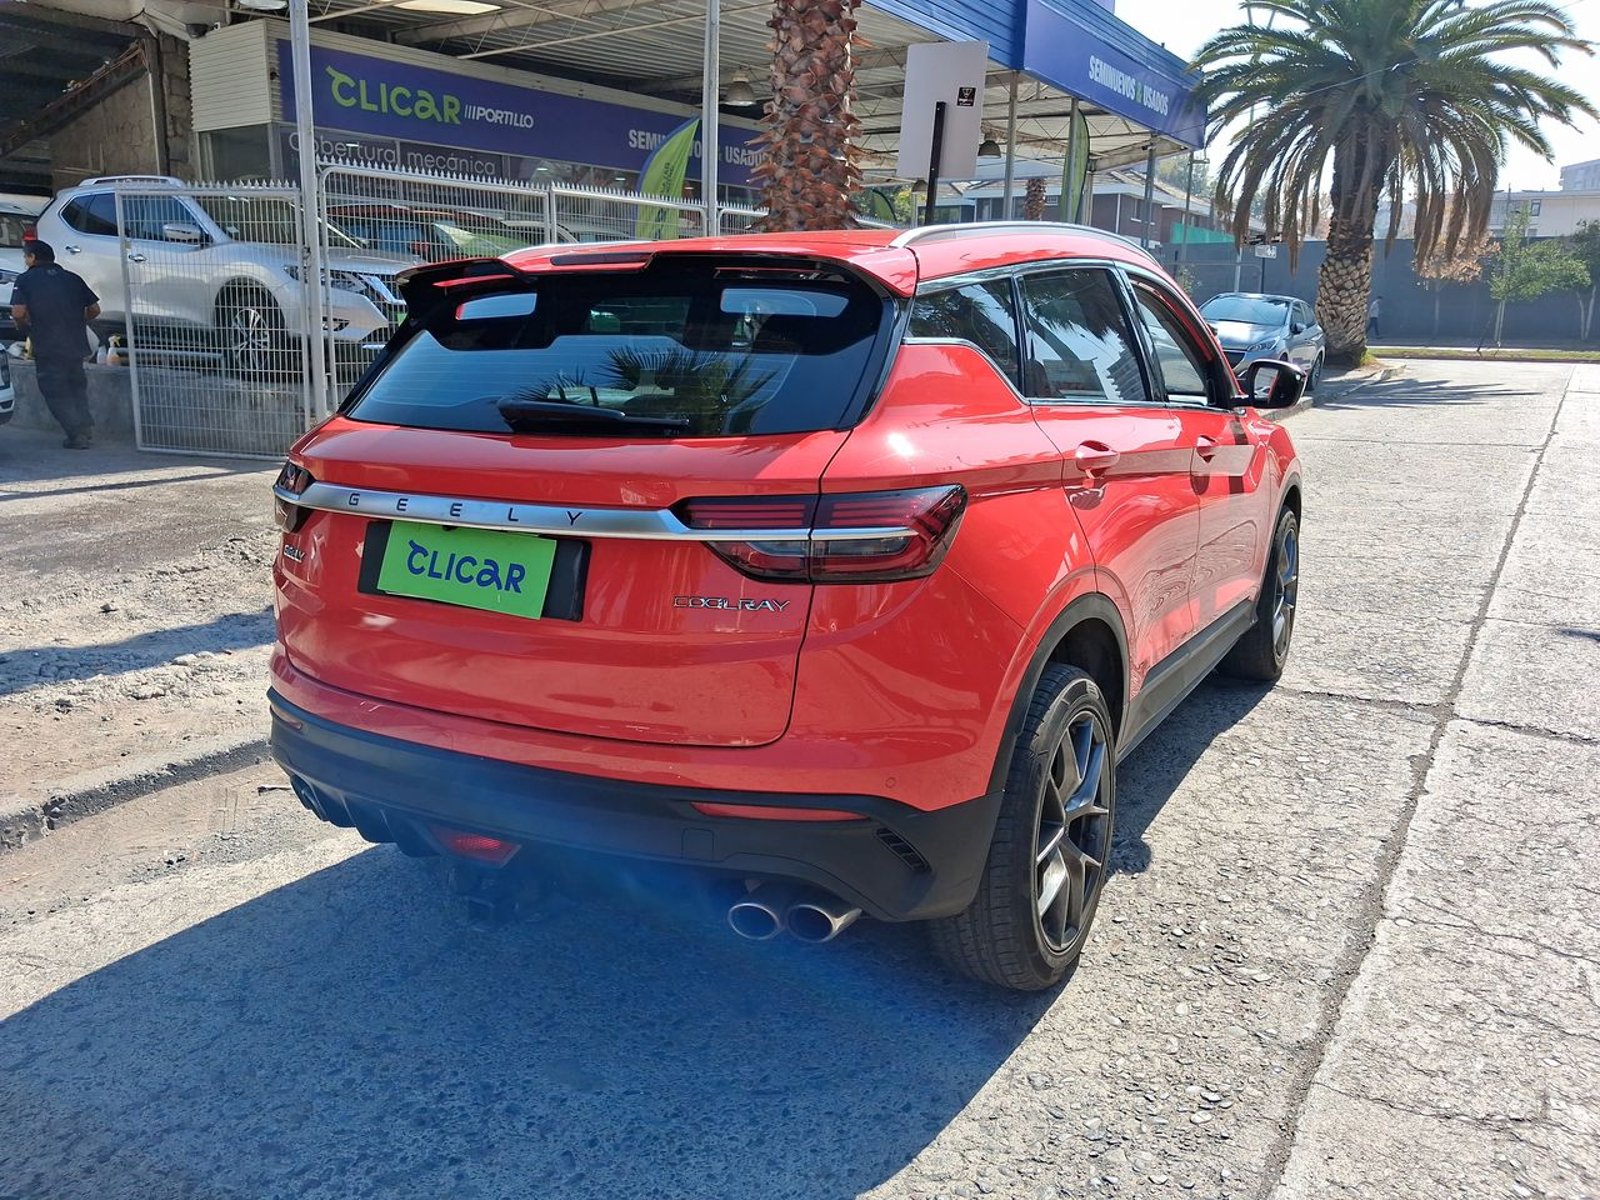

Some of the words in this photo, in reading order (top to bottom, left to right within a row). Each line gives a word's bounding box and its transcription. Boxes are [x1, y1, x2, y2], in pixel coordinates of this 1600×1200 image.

[1088, 55, 1136, 101] SEMINUEVOS
[1143, 85, 1169, 116] USADOS
[407, 149, 497, 176] mecánica
[348, 492, 582, 526] GEELY
[673, 595, 791, 613] COOLRAY
